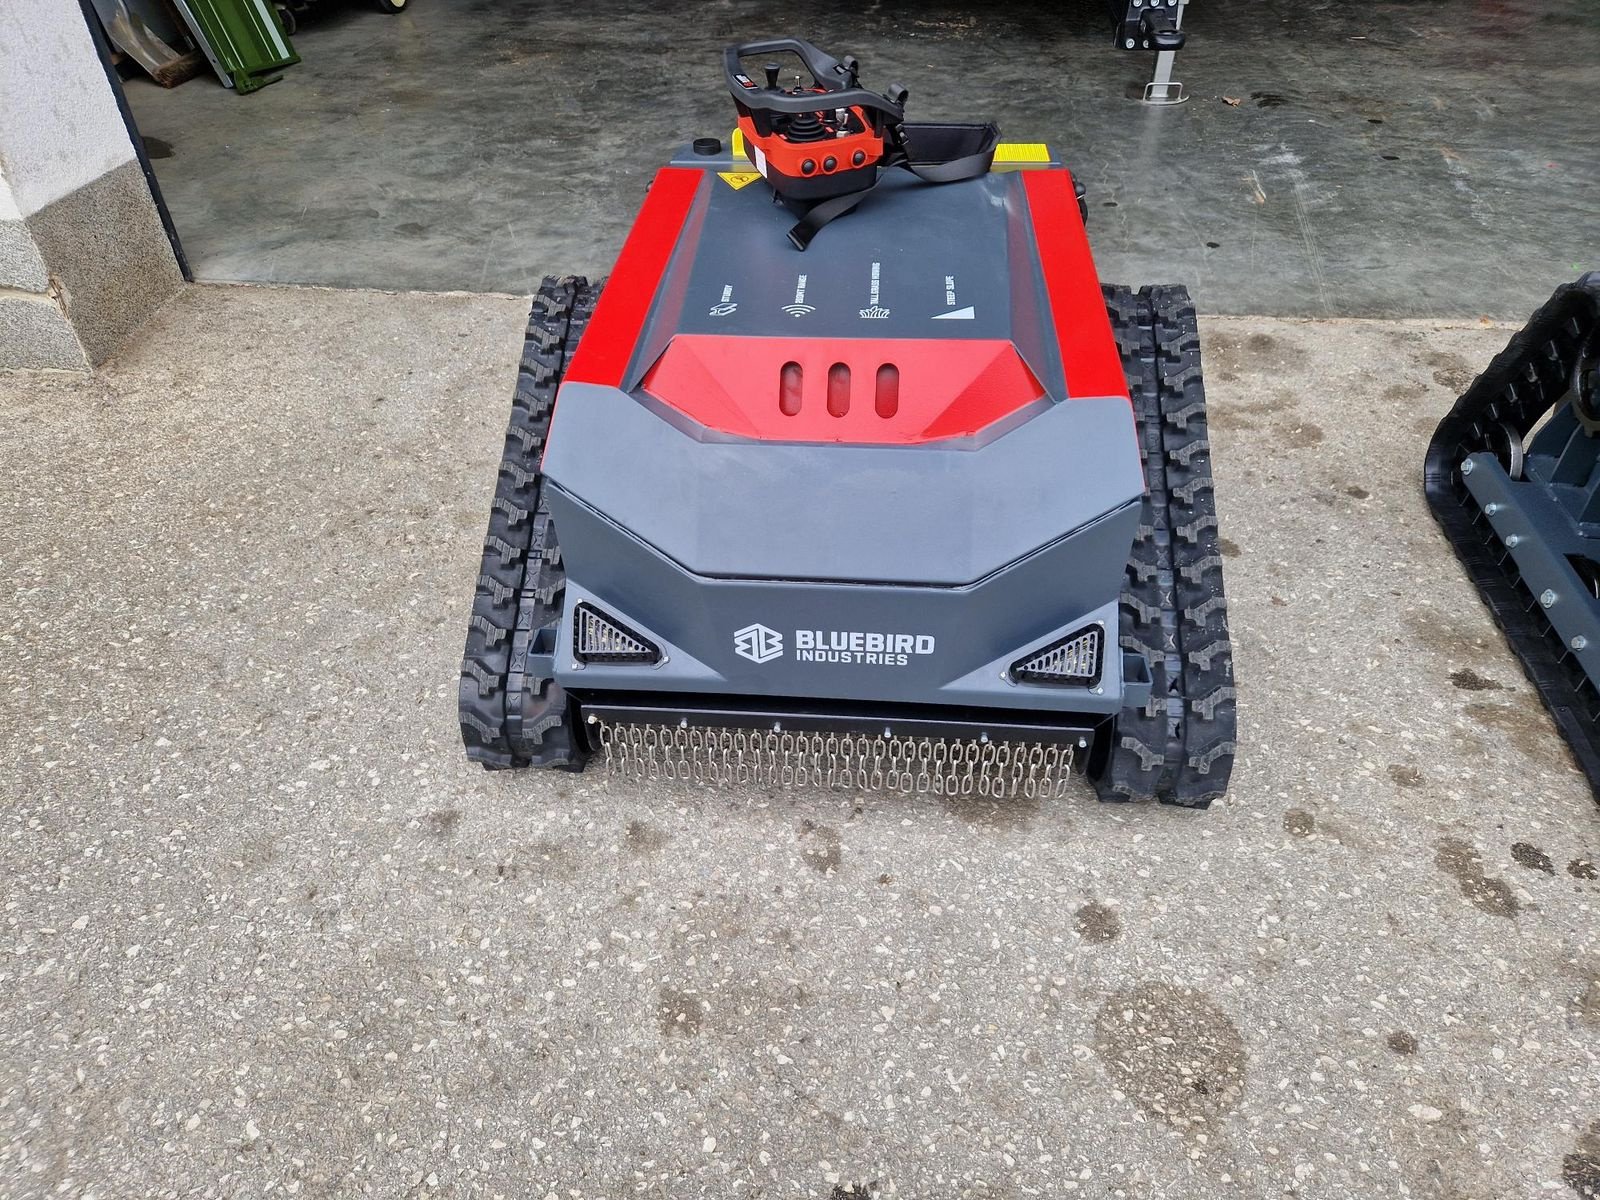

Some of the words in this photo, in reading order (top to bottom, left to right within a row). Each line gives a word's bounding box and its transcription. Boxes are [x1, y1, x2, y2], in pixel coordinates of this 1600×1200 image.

[945, 275, 955, 290] SLOPE
[946, 290, 956, 306] STEEP
[795, 629, 936, 655] BLUEBIRD
[796, 649, 908, 666] INDUSTRIES
